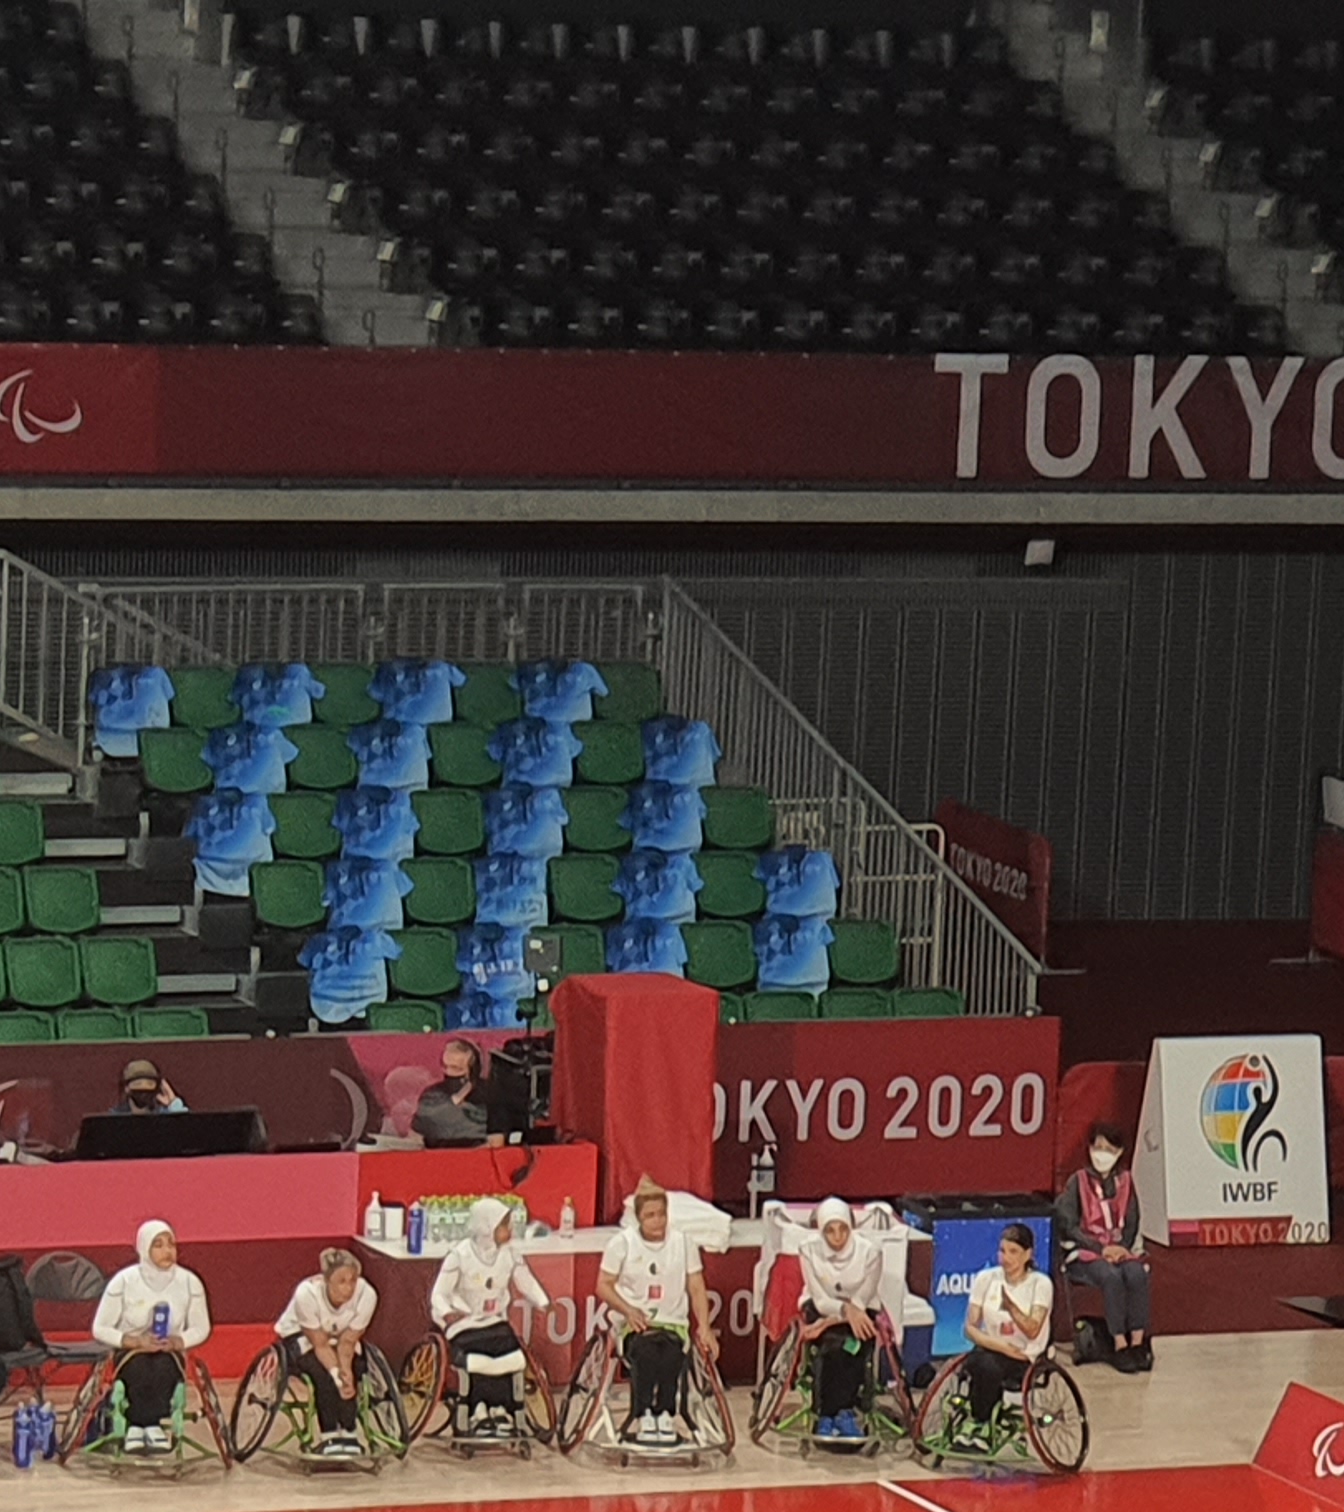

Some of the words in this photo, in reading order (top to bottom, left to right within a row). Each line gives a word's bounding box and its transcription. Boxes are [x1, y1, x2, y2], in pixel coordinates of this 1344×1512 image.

[883, 1072, 1045, 1139] 2020
[1222, 1181, 1279, 1203] IWBF
[1202, 1223, 1273, 1244] TOKYO
